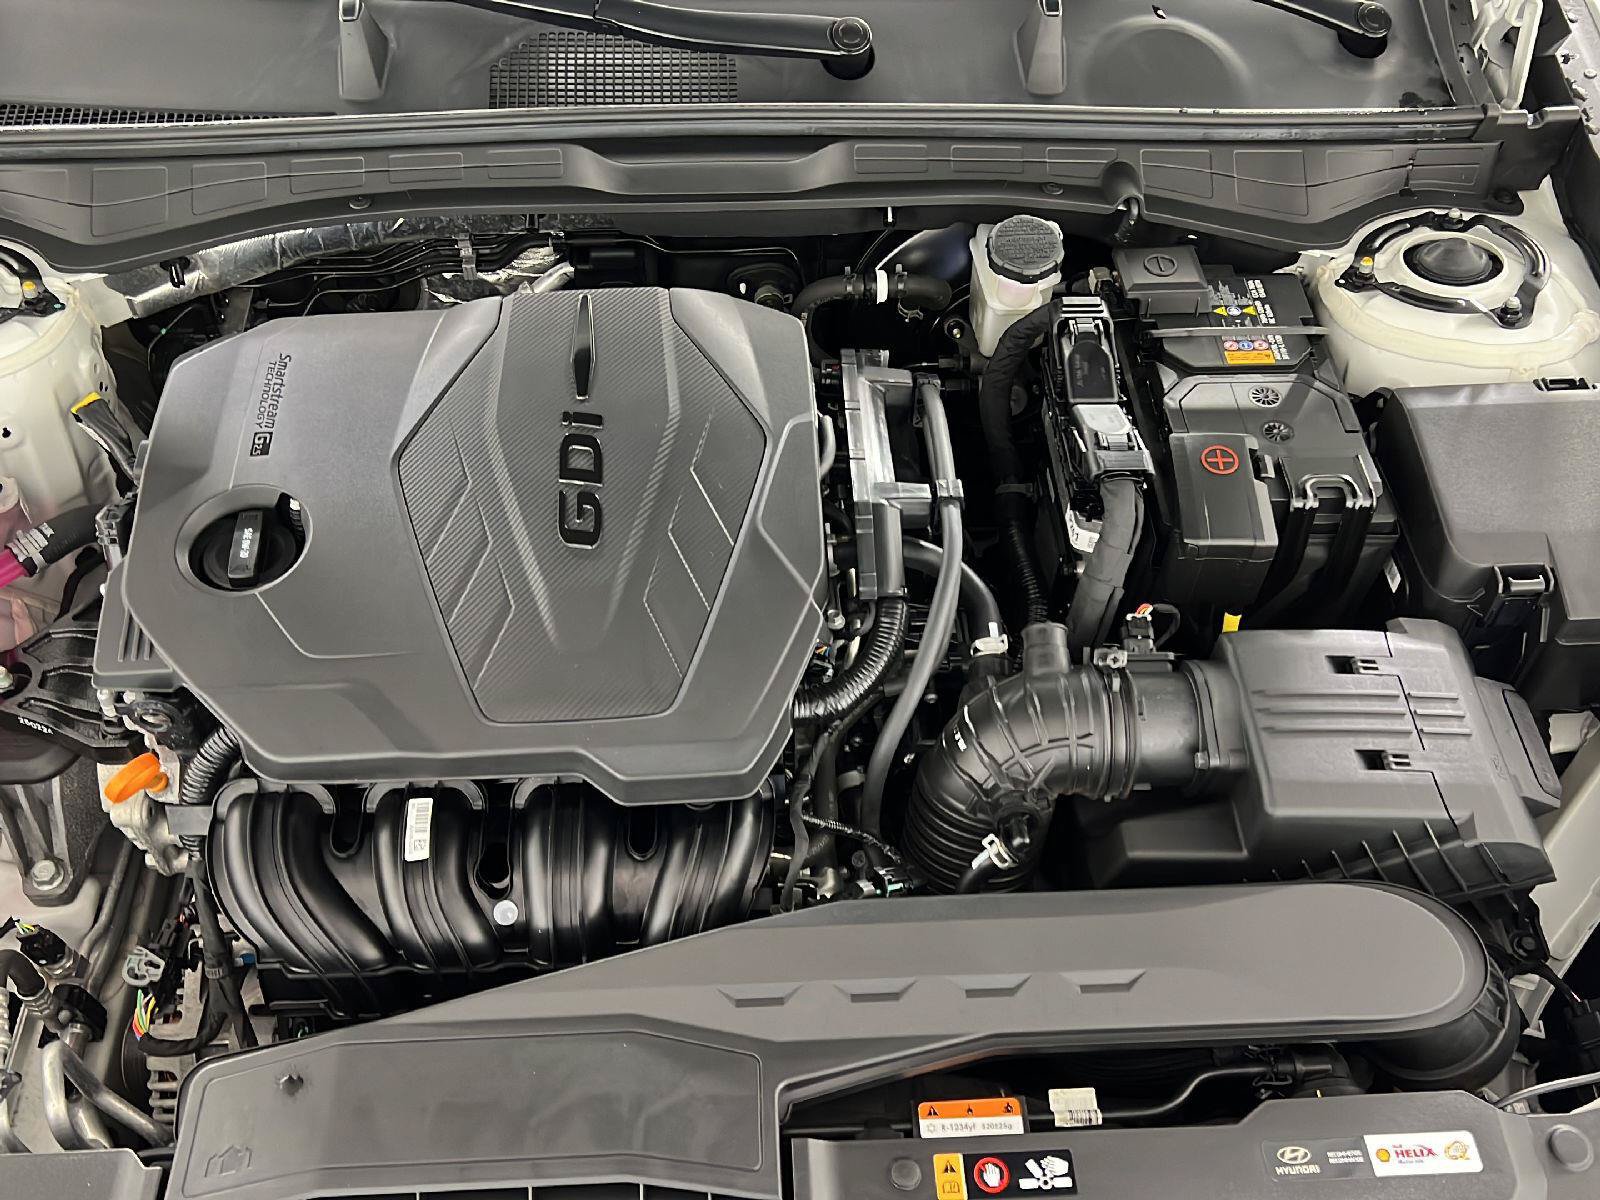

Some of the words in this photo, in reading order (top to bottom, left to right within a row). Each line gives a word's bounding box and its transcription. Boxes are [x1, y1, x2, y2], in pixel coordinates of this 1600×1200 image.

[255, 361, 277, 429] TECHNOLOGY
[264, 352, 292, 430] Smartstream
[558, 411, 603, 549] GDi
[1275, 1164, 1320, 1175] HYUNDAI
[1394, 1147, 1436, 1159] HELIX
